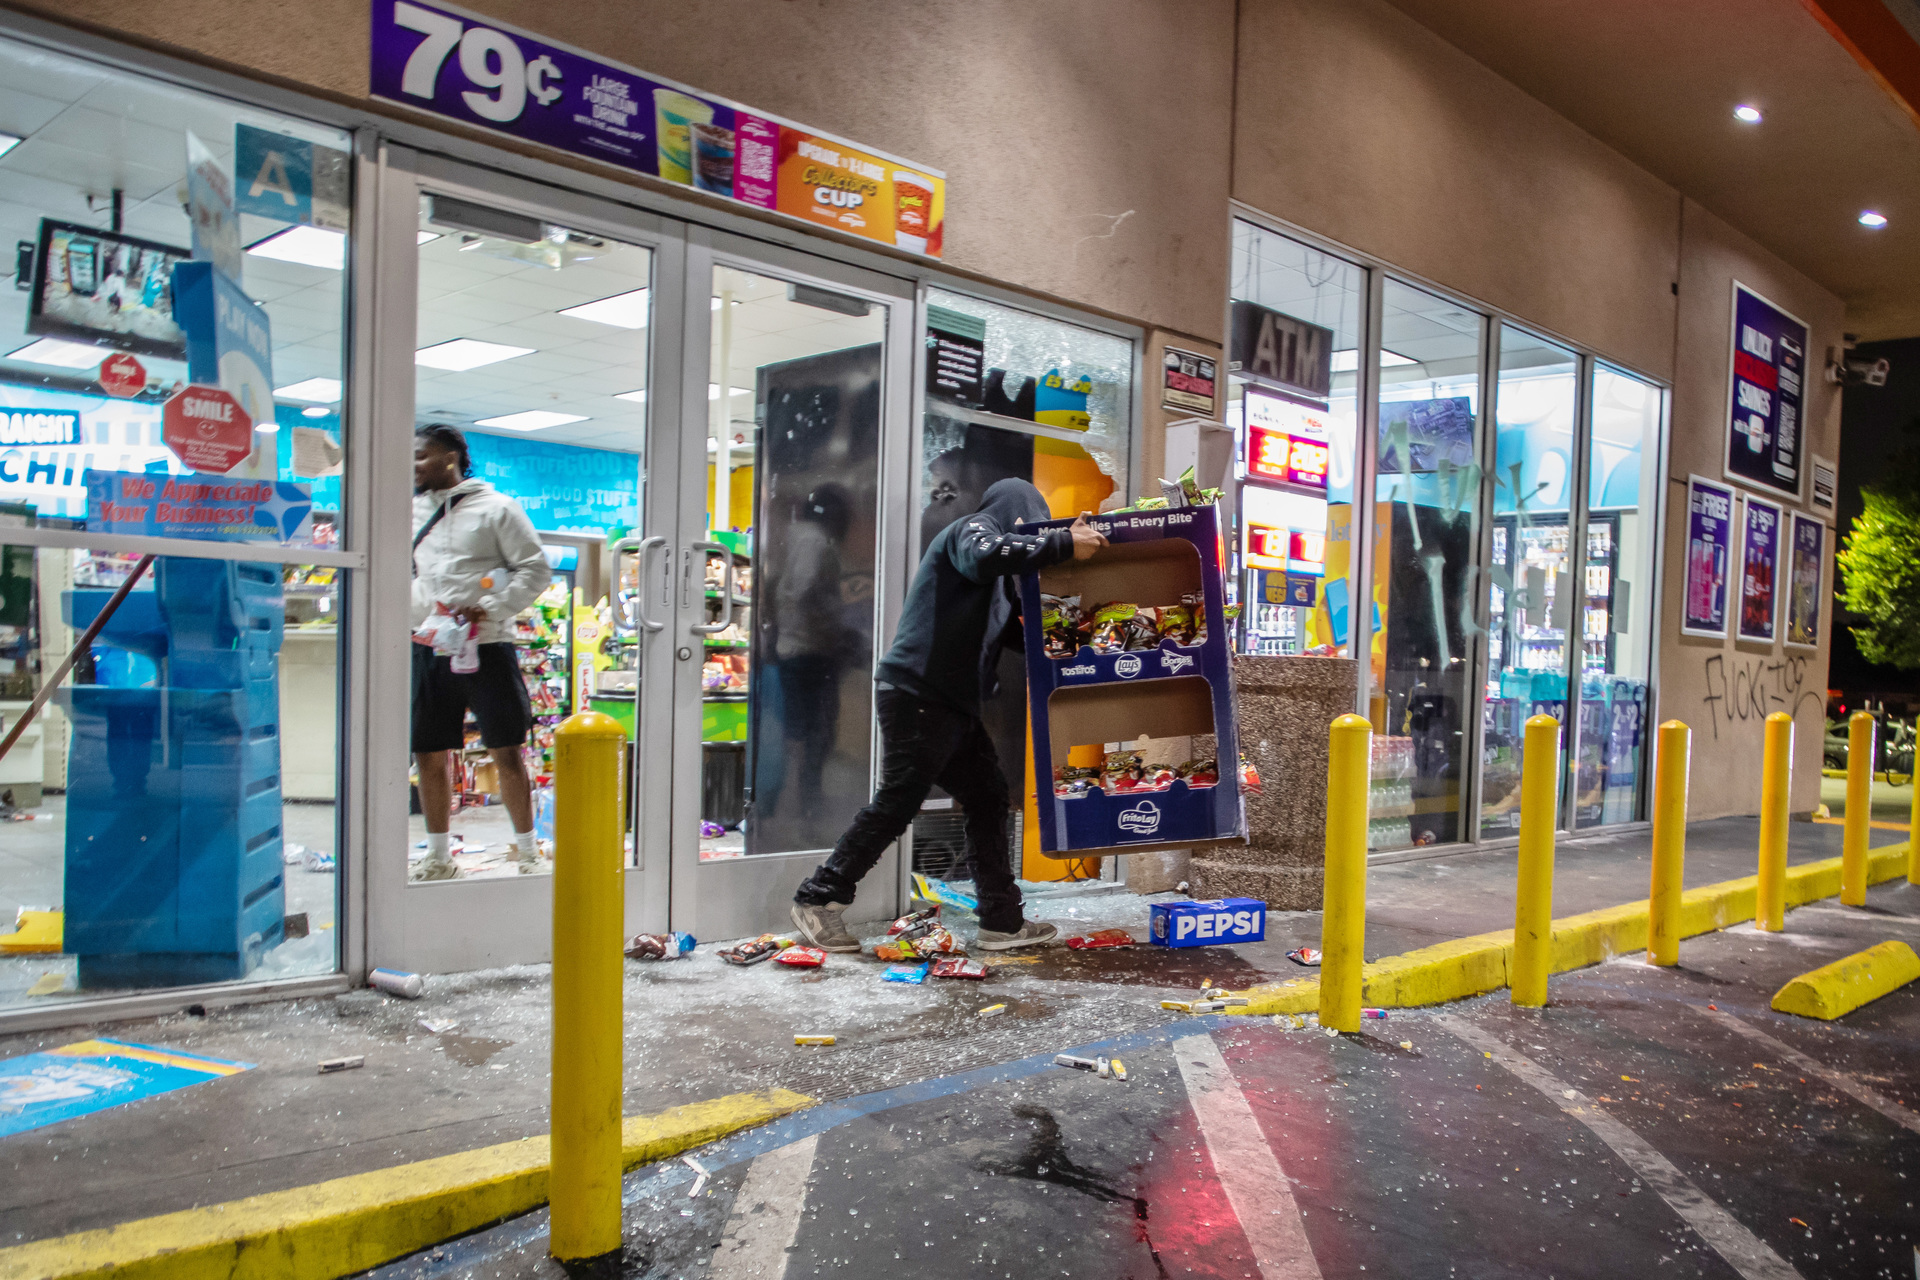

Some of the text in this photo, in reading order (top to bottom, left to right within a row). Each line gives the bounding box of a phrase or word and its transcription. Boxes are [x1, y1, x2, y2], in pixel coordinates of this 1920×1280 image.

[394, 1, 563, 123] 79¢
[592, 74, 630, 99] LARGE
[582, 86, 638, 116] FOUNTAIN
[592, 104, 628, 127] DRINK
[248, 151, 299, 207] A
[813, 187, 863, 209] CUP
[1252, 312, 1321, 389] ATM
[182, 396, 234, 424] SMILE
[122, 478, 273, 502] We Appreciate
[587, 488, 631, 506] STUFF
[100, 501, 256, 524] Your Business!
[1702, 491, 1728, 520] FREE
[1130, 515, 1165, 528] Every
[1704, 654, 1766, 740] FUCK
[1176, 910, 1261, 940] PEPSI
